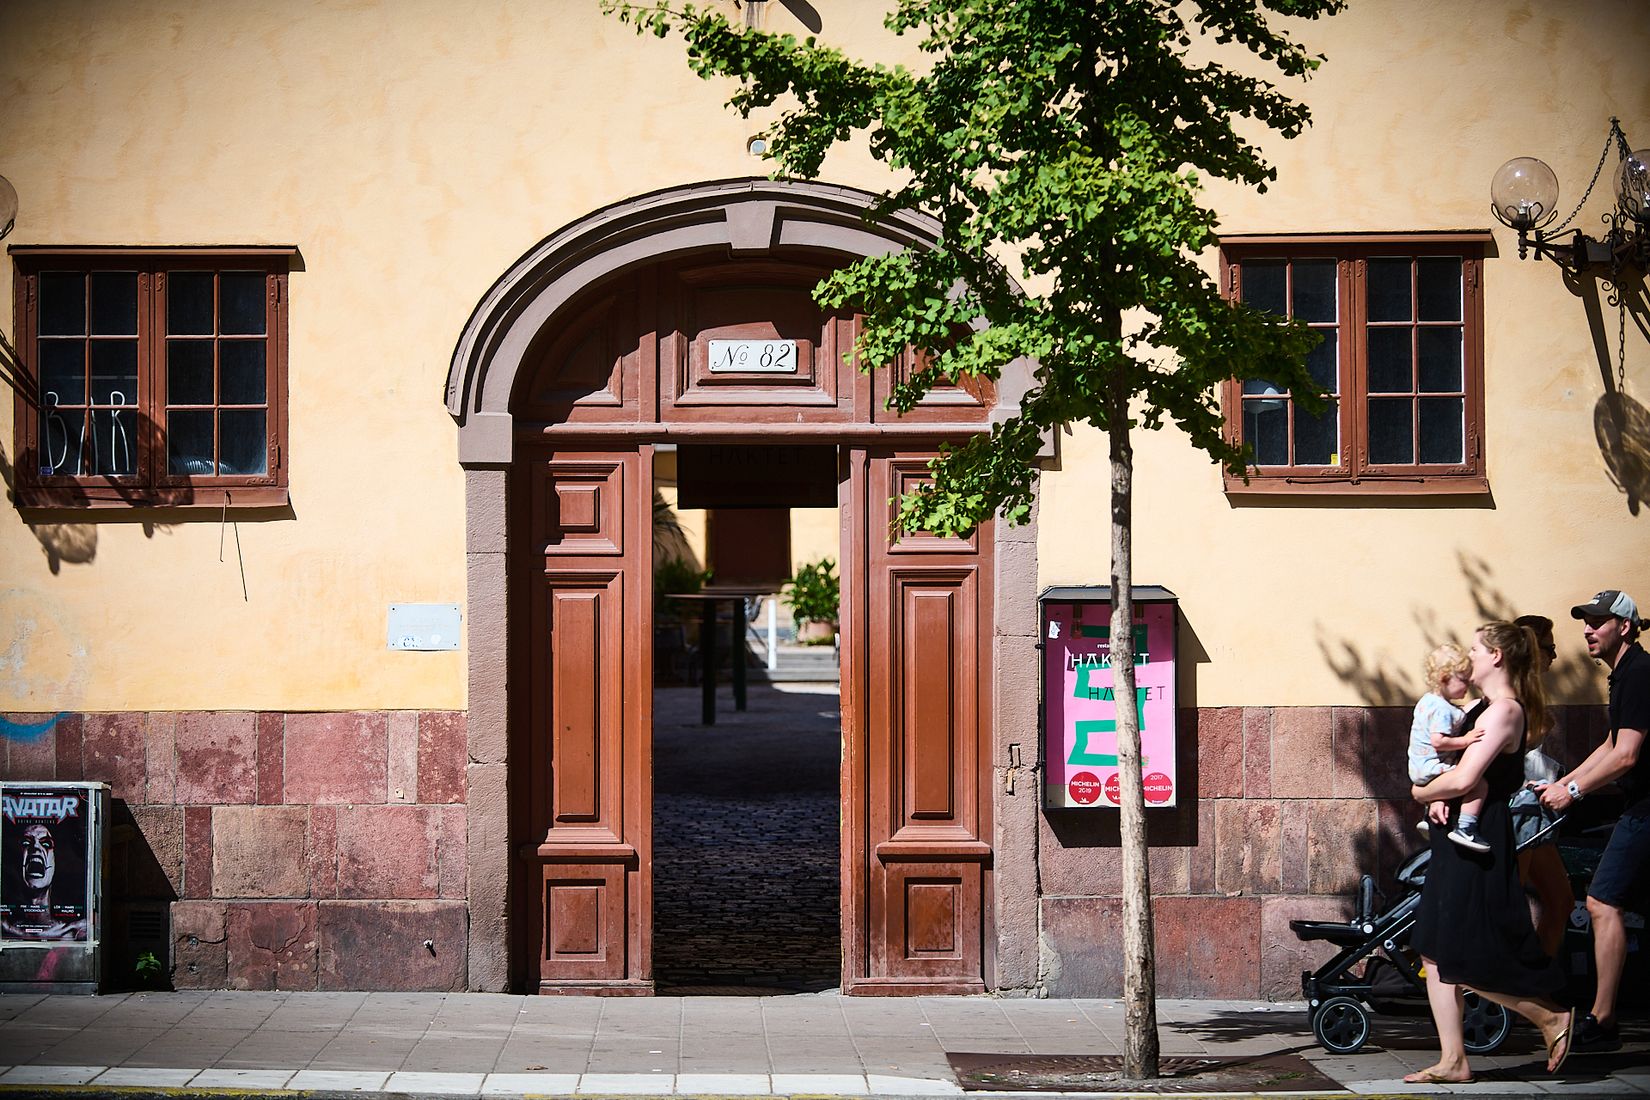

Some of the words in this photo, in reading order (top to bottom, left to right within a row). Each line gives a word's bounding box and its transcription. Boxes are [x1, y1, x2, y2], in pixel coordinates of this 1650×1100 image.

[760, 344, 791, 367] 82
[44, 391, 130, 475] BAR
[3, 795, 78, 820] AVATAR
